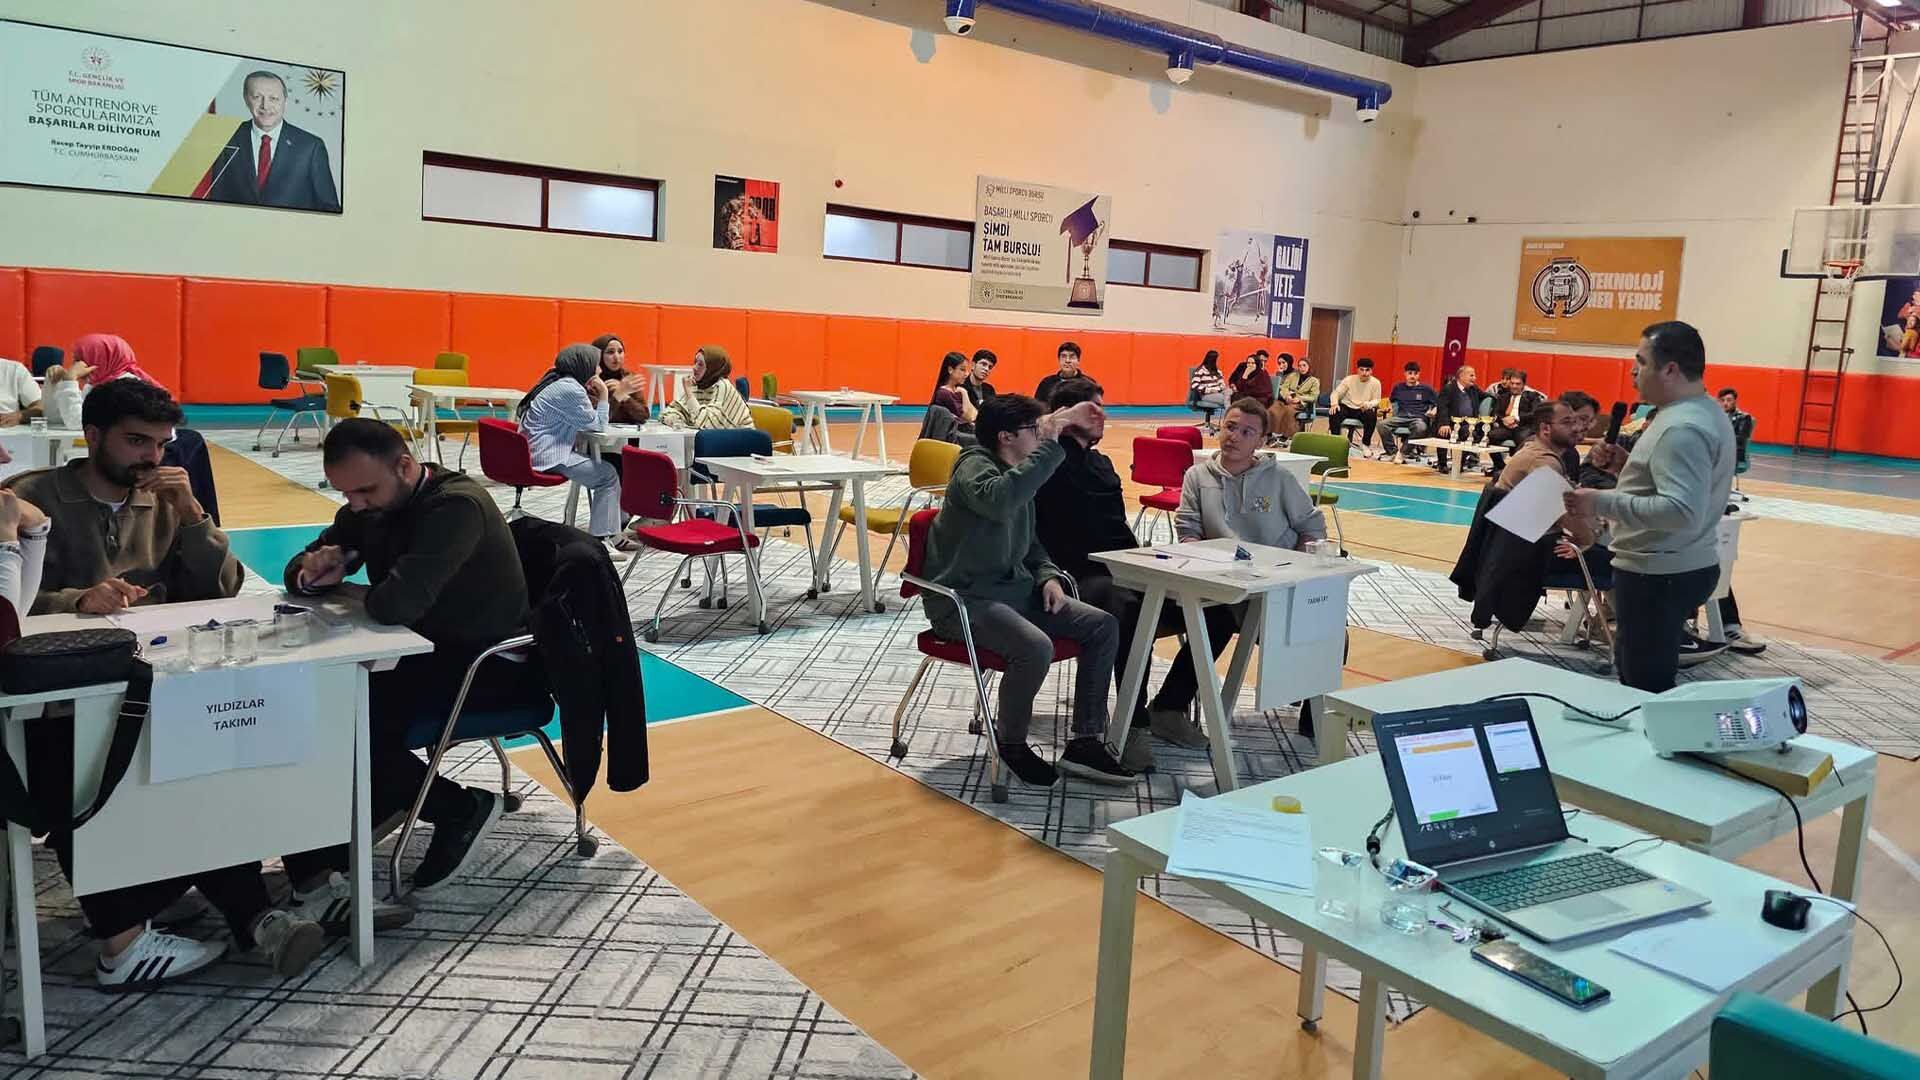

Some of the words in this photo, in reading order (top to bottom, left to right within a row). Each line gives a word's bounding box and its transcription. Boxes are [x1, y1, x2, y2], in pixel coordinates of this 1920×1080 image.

[32, 89, 62, 103] TÜM
[67, 95, 140, 113] ANTRENÖR
[143, 104, 158, 115] VE
[36, 103, 154, 125] SPORCULARIMIZA
[29, 116, 94, 130] BAŞARILAR
[98, 123, 160, 137] DİLİYORUM
[983, 219, 1010, 238] ŞİMDİ
[983, 239, 1000, 253] TAM
[1003, 241, 1040, 256] BURSLU!
[1618, 293, 1662, 311] YERDE
[1271, 301, 1293, 329] ULAŞ
[206, 699, 264, 713] YILDIZLAR
[213, 717, 257, 731] TAKIMI
